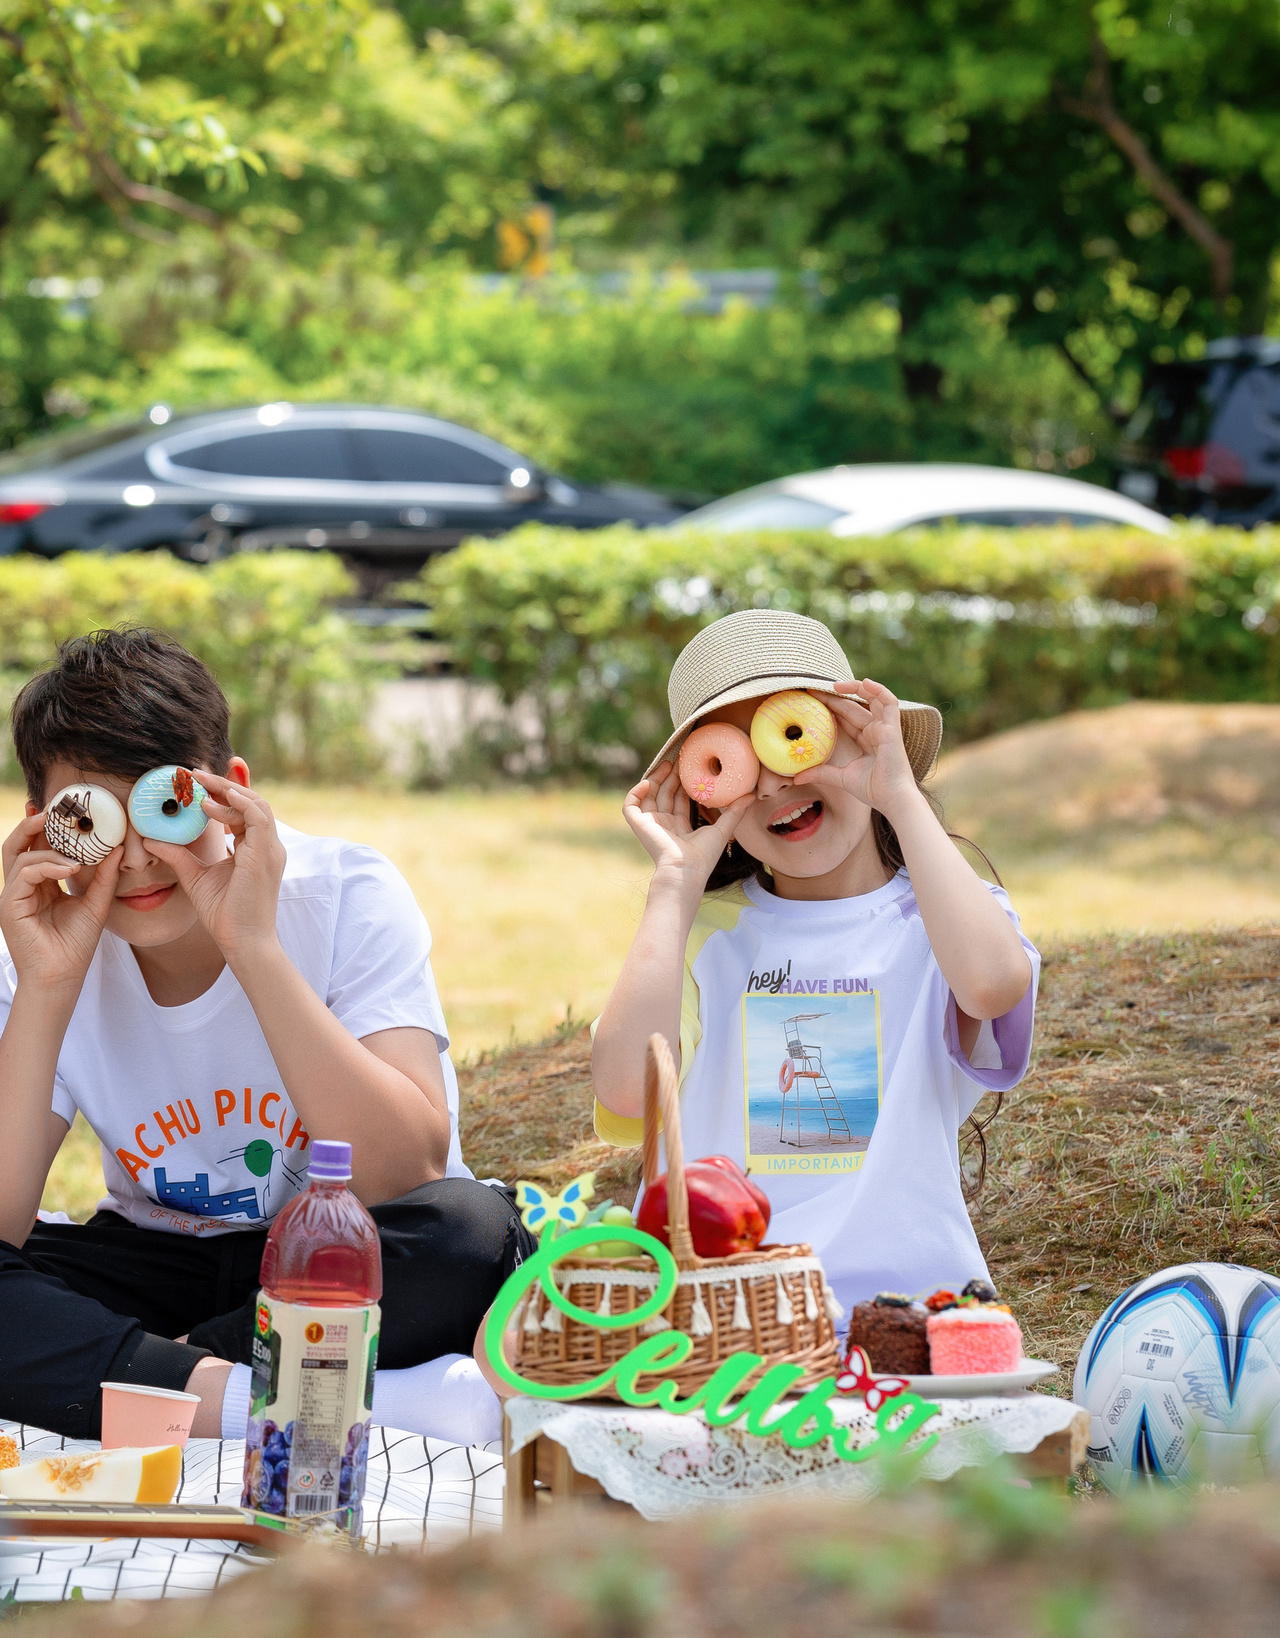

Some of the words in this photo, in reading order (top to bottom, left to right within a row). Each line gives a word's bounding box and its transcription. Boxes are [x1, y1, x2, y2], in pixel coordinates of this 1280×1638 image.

[747, 959, 791, 994] hey!
[779, 979, 828, 994] HAVE
[833, 978, 874, 995] FUN,
[767, 1155, 861, 1171] IMPORTANT
[149, 1208, 168, 1220] OF
[168, 1214, 191, 1234] THE
